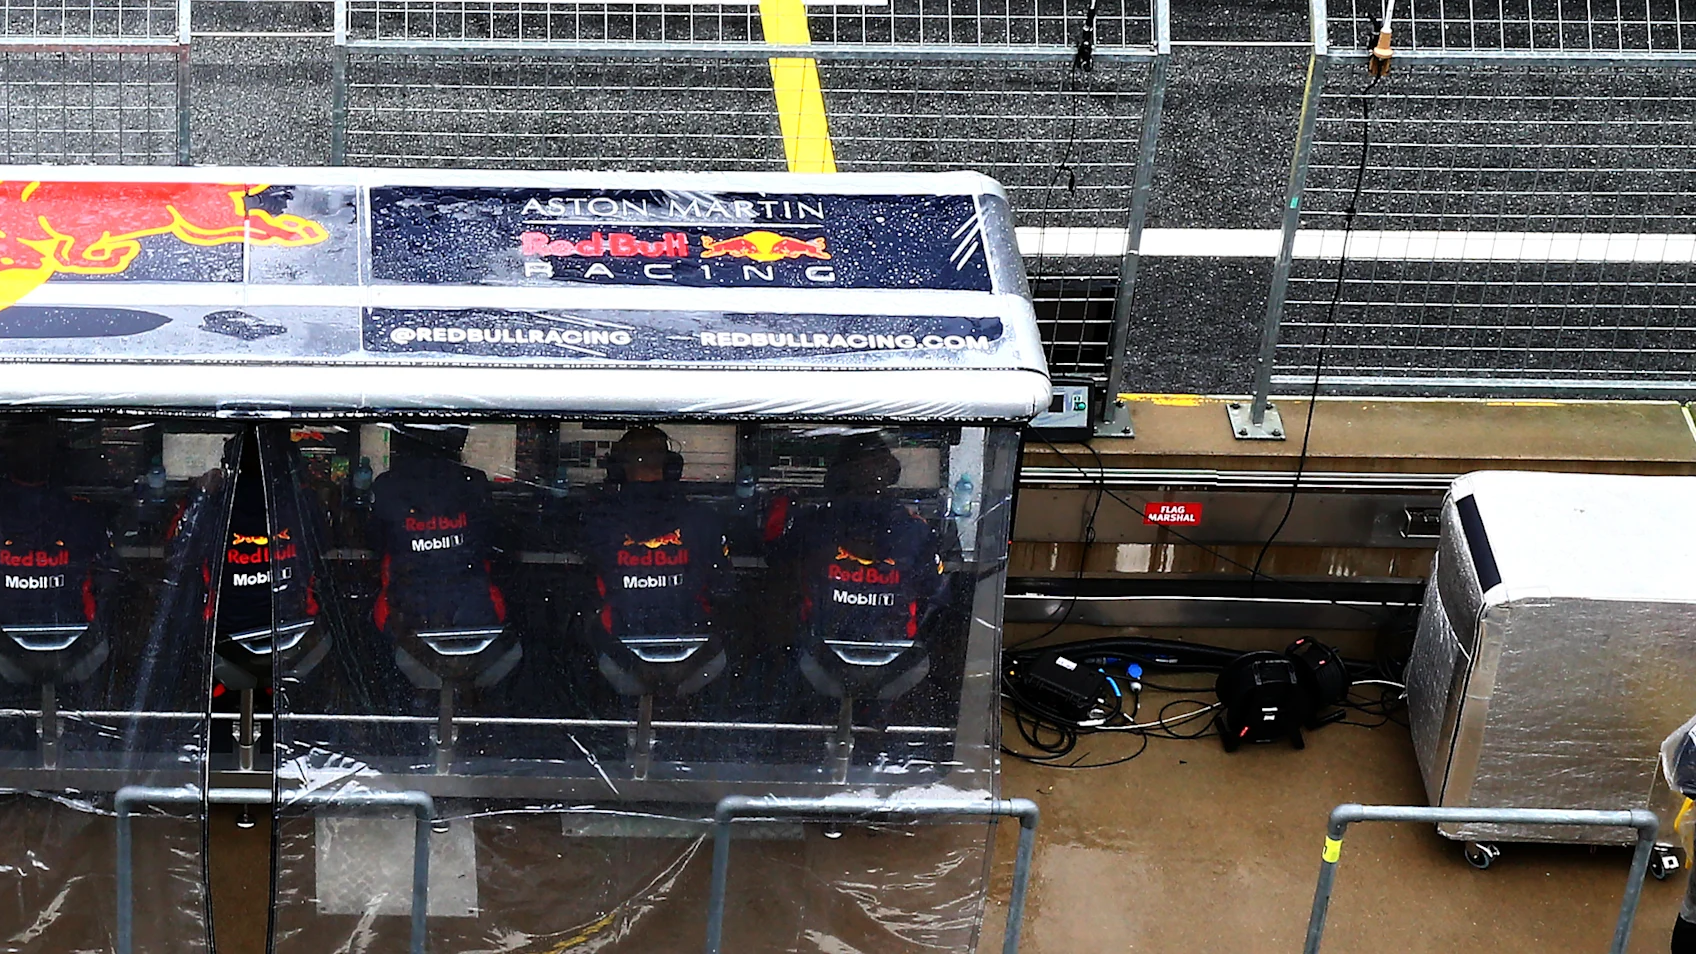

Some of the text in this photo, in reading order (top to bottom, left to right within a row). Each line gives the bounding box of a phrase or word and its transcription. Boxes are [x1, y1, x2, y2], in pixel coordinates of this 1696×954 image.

[521, 197, 825, 220] ASTON MARTIN
[520, 231, 689, 258] Red Bull
[523, 261, 836, 283] RACING
[390, 326, 632, 346] @REDBULLRACING
[700, 331, 990, 351] REDBULLRACING.COM
[1147, 513, 1196, 522] MARSHAL
[1160, 505, 1186, 514] FLAG
[405, 512, 467, 531] Red Bull
[411, 536, 450, 552] Mobil
[0, 549, 70, 566] Red Bull
[227, 547, 262, 564] Red
[617, 549, 689, 566] Red Bull
[5, 575, 48, 589] Mobil
[623, 575, 666, 588] Mobil
[828, 564, 900, 584] Red Bull
[833, 589, 877, 606] Mobil
